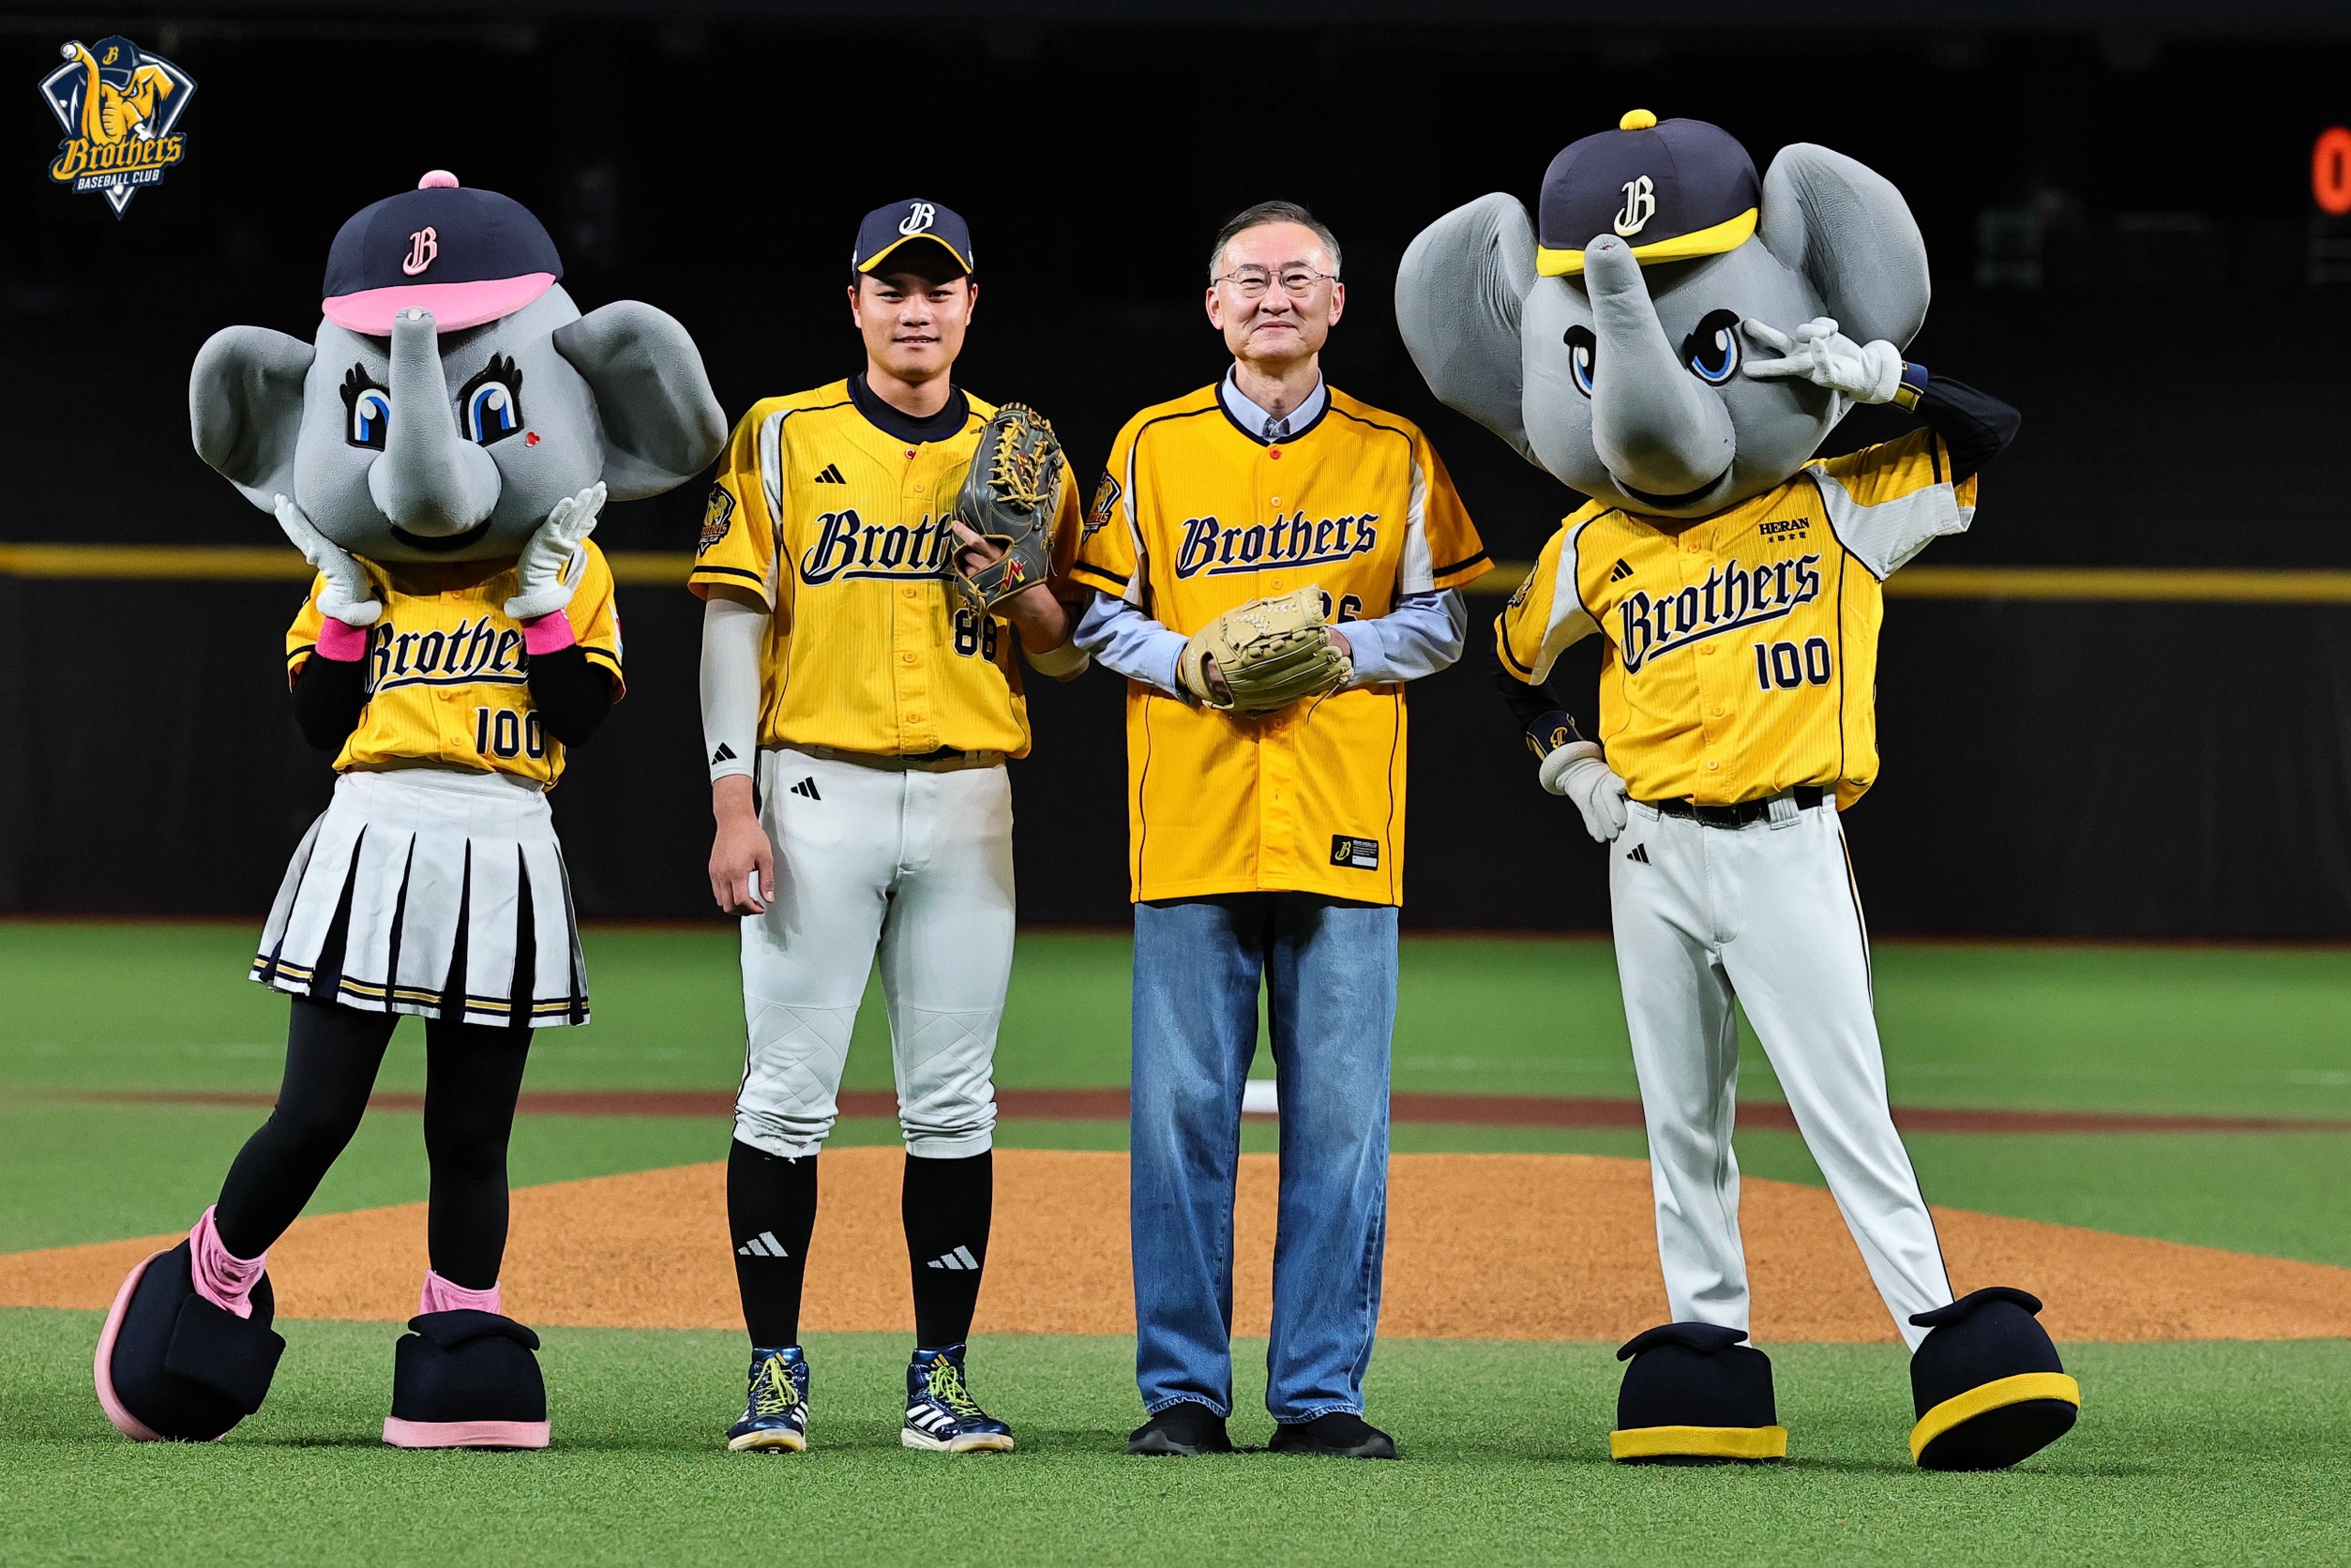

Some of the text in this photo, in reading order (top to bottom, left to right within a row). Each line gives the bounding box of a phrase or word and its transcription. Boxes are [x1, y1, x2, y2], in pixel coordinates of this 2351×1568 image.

[898, 203, 936, 235] B
[1614, 174, 1656, 236] B
[402, 226, 438, 276] B
[800, 509, 955, 587] Broth
[1175, 510, 1380, 580] Brothers
[1759, 518, 1810, 535] HERAN
[953, 608, 998, 664] 88
[1619, 552, 1821, 675] Brothers
[1753, 636, 1833, 692] 100
[475, 707, 547, 761] 100
[1334, 840, 1351, 861] B
